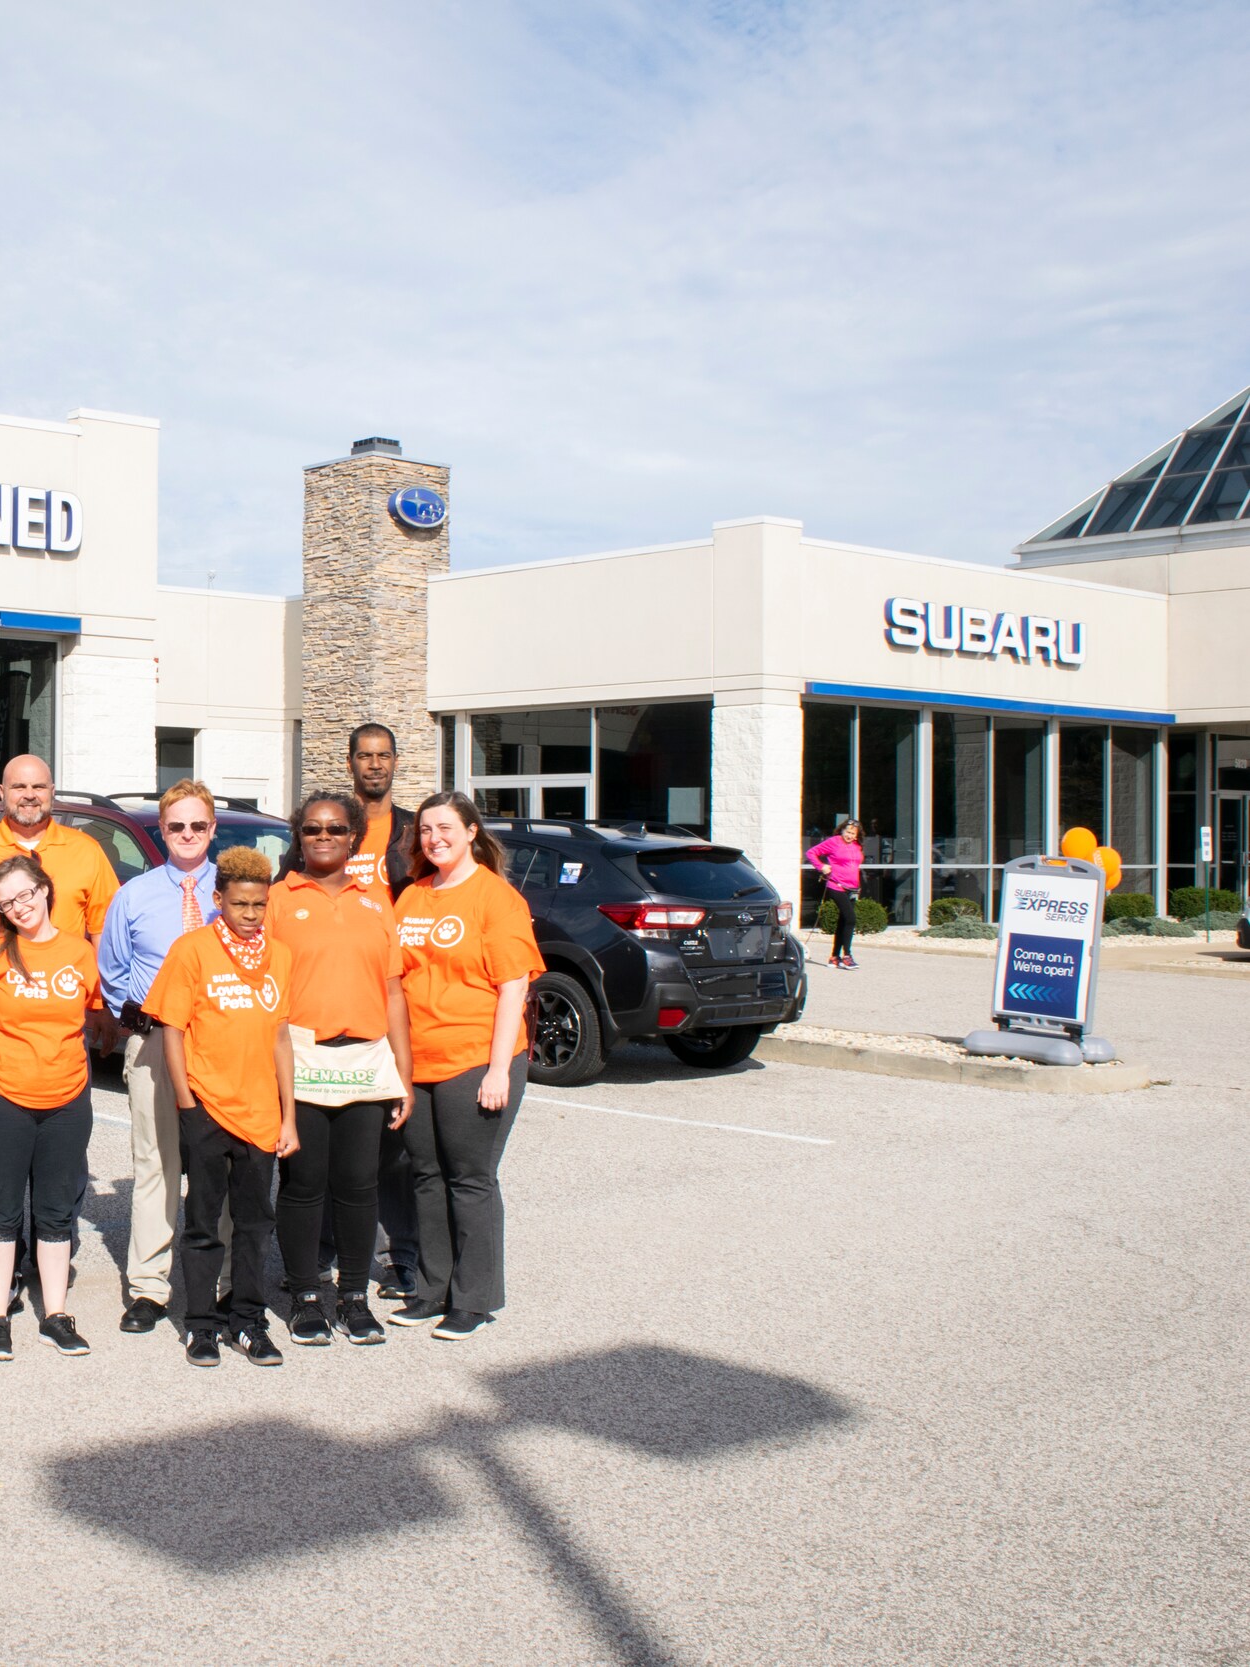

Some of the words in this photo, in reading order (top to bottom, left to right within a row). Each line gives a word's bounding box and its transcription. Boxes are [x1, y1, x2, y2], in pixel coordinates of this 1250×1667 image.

[884, 597, 1086, 665] SUBARU
[350, 853, 375, 862] BARU
[344, 863, 375, 875] oves
[1014, 888, 1049, 899] SUBARU
[1012, 897, 1089, 915] EXPRESS
[1045, 912, 1086, 924] SERVICE
[399, 933, 426, 947] Pets
[1014, 948, 1044, 961] Come
[1047, 953, 1060, 963] on
[1063, 953, 1075, 965] in.
[1013, 960, 1041, 974] We're
[1044, 965, 1074, 978] open!
[6, 970, 47, 988] Los
[212, 973, 241, 983] SUBA
[14, 984, 49, 999] Pets
[207, 983, 252, 998] Loves
[220, 995, 254, 1010] Pets
[294, 1066, 376, 1083] MENARDS
